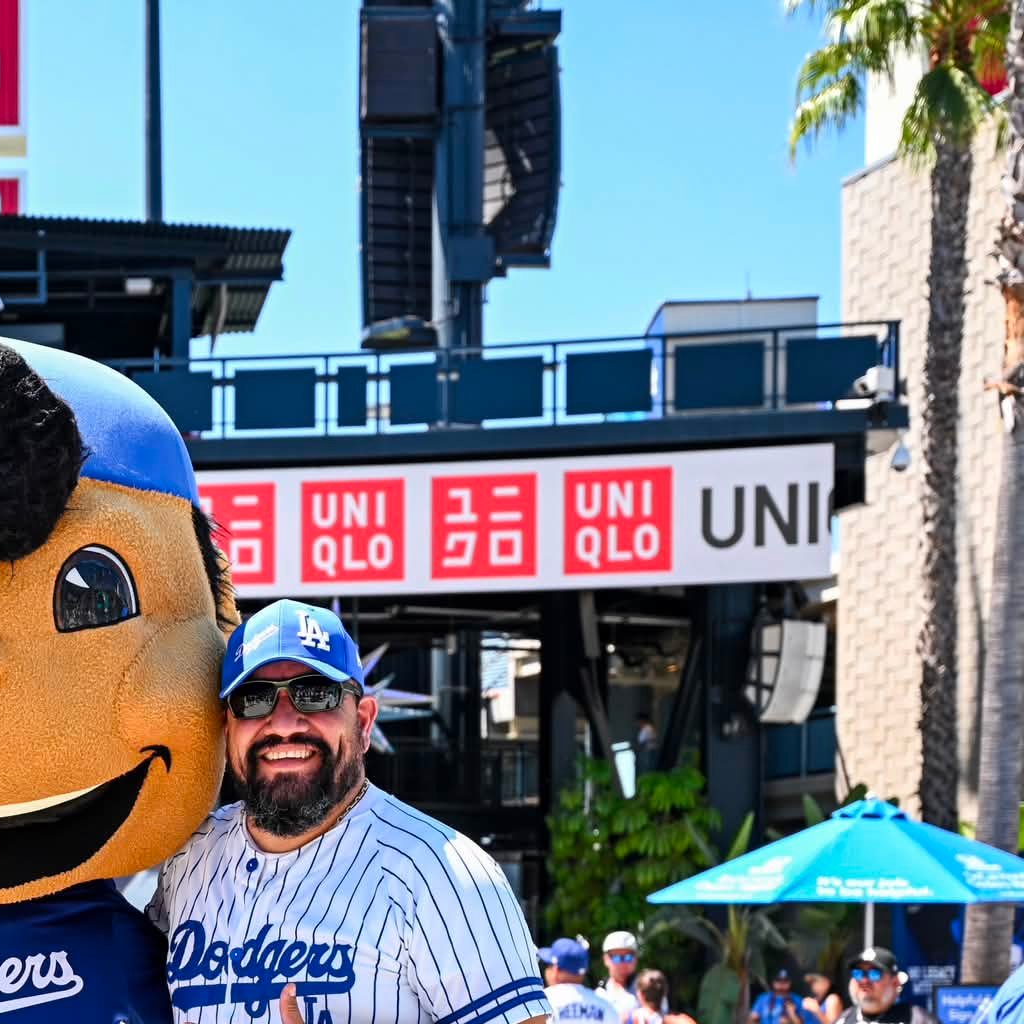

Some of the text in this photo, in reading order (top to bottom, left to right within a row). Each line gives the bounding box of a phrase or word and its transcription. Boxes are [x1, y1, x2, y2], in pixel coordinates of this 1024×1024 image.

[312, 491, 387, 528] UNI
[576, 480, 653, 518] UNI
[701, 482, 834, 549] UNI
[312, 534, 393, 577] QLO
[576, 523, 660, 568] QLO
[296, 610, 330, 652] LA
[167, 920, 356, 1018] Dodgers
